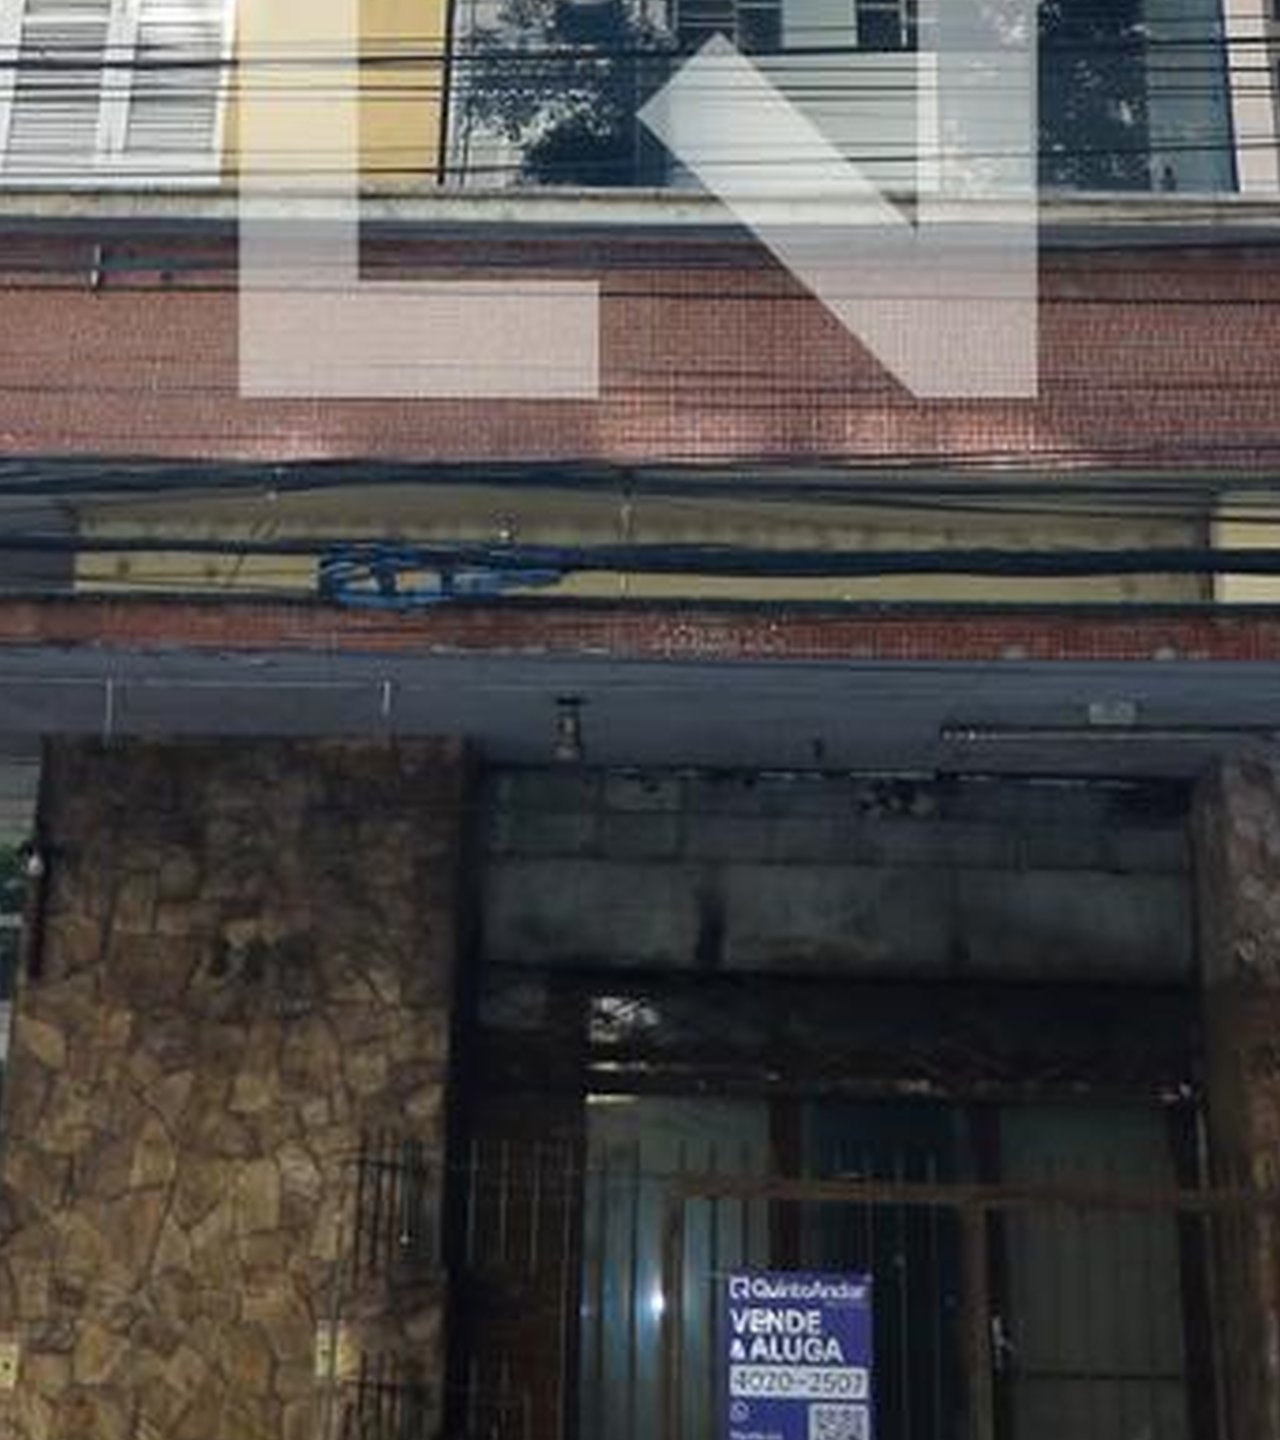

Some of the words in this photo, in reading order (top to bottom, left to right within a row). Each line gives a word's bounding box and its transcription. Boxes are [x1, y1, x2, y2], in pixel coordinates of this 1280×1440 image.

[752, 1277, 866, 1300] QuintoAndar
[729, 1308, 821, 1335] VENDE
[750, 1337, 845, 1363] ALUGA
